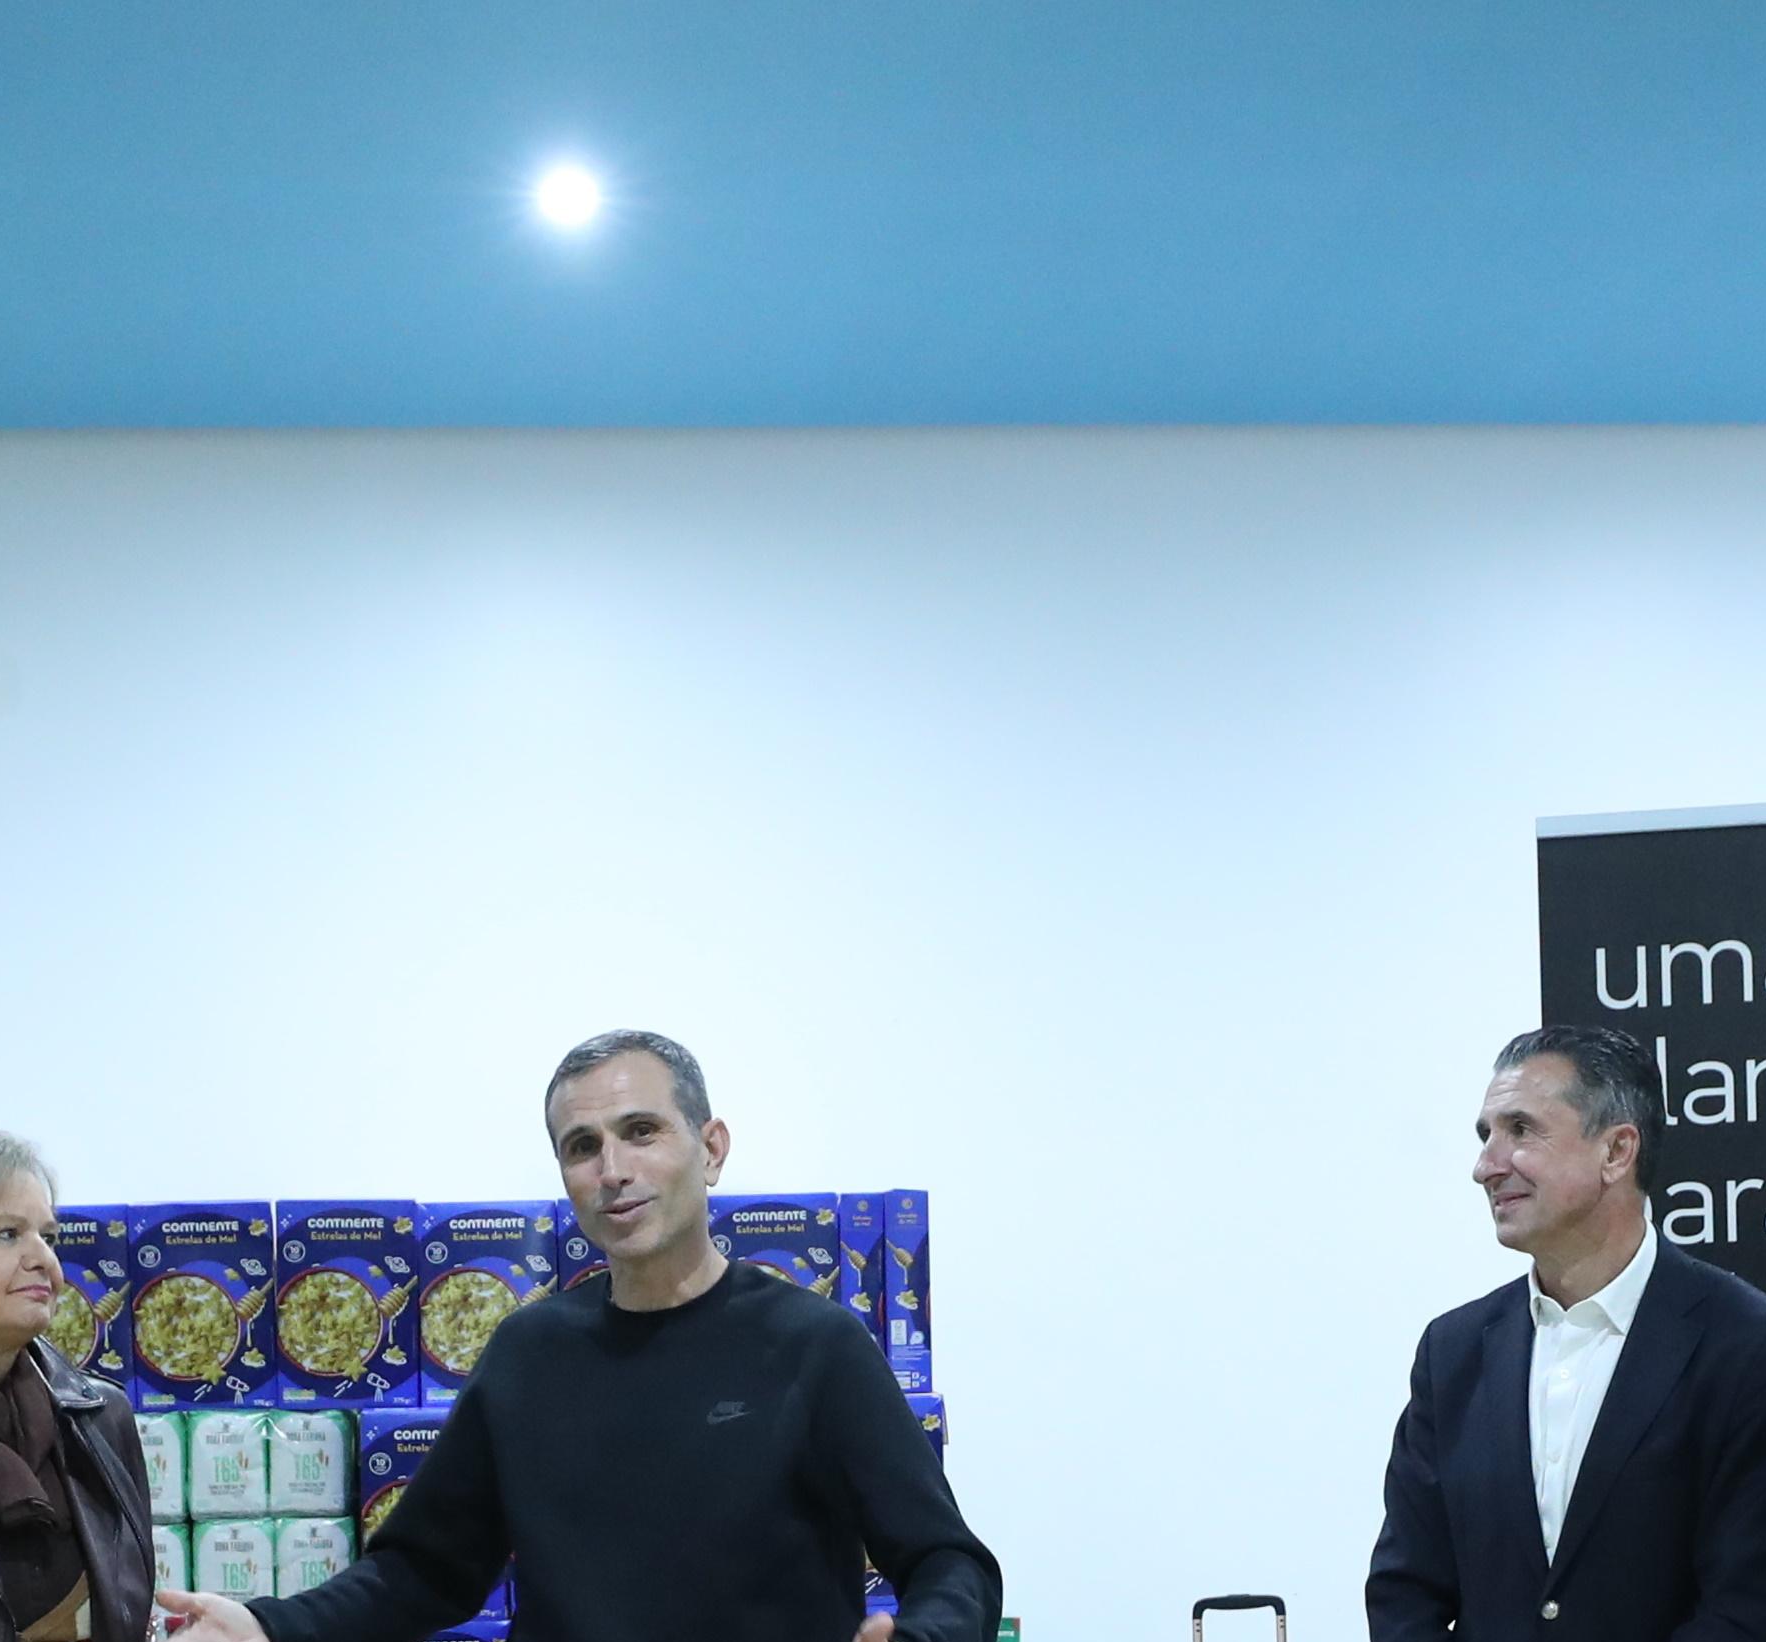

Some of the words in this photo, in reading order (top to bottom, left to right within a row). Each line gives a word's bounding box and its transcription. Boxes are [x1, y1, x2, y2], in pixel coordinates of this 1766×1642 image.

[732, 1210, 807, 1222] CONTINENTE
[162, 1221, 239, 1233] CONTINENTE
[307, 1217, 384, 1229] CONTINENTE
[449, 1217, 525, 1230] CONTINENTE
